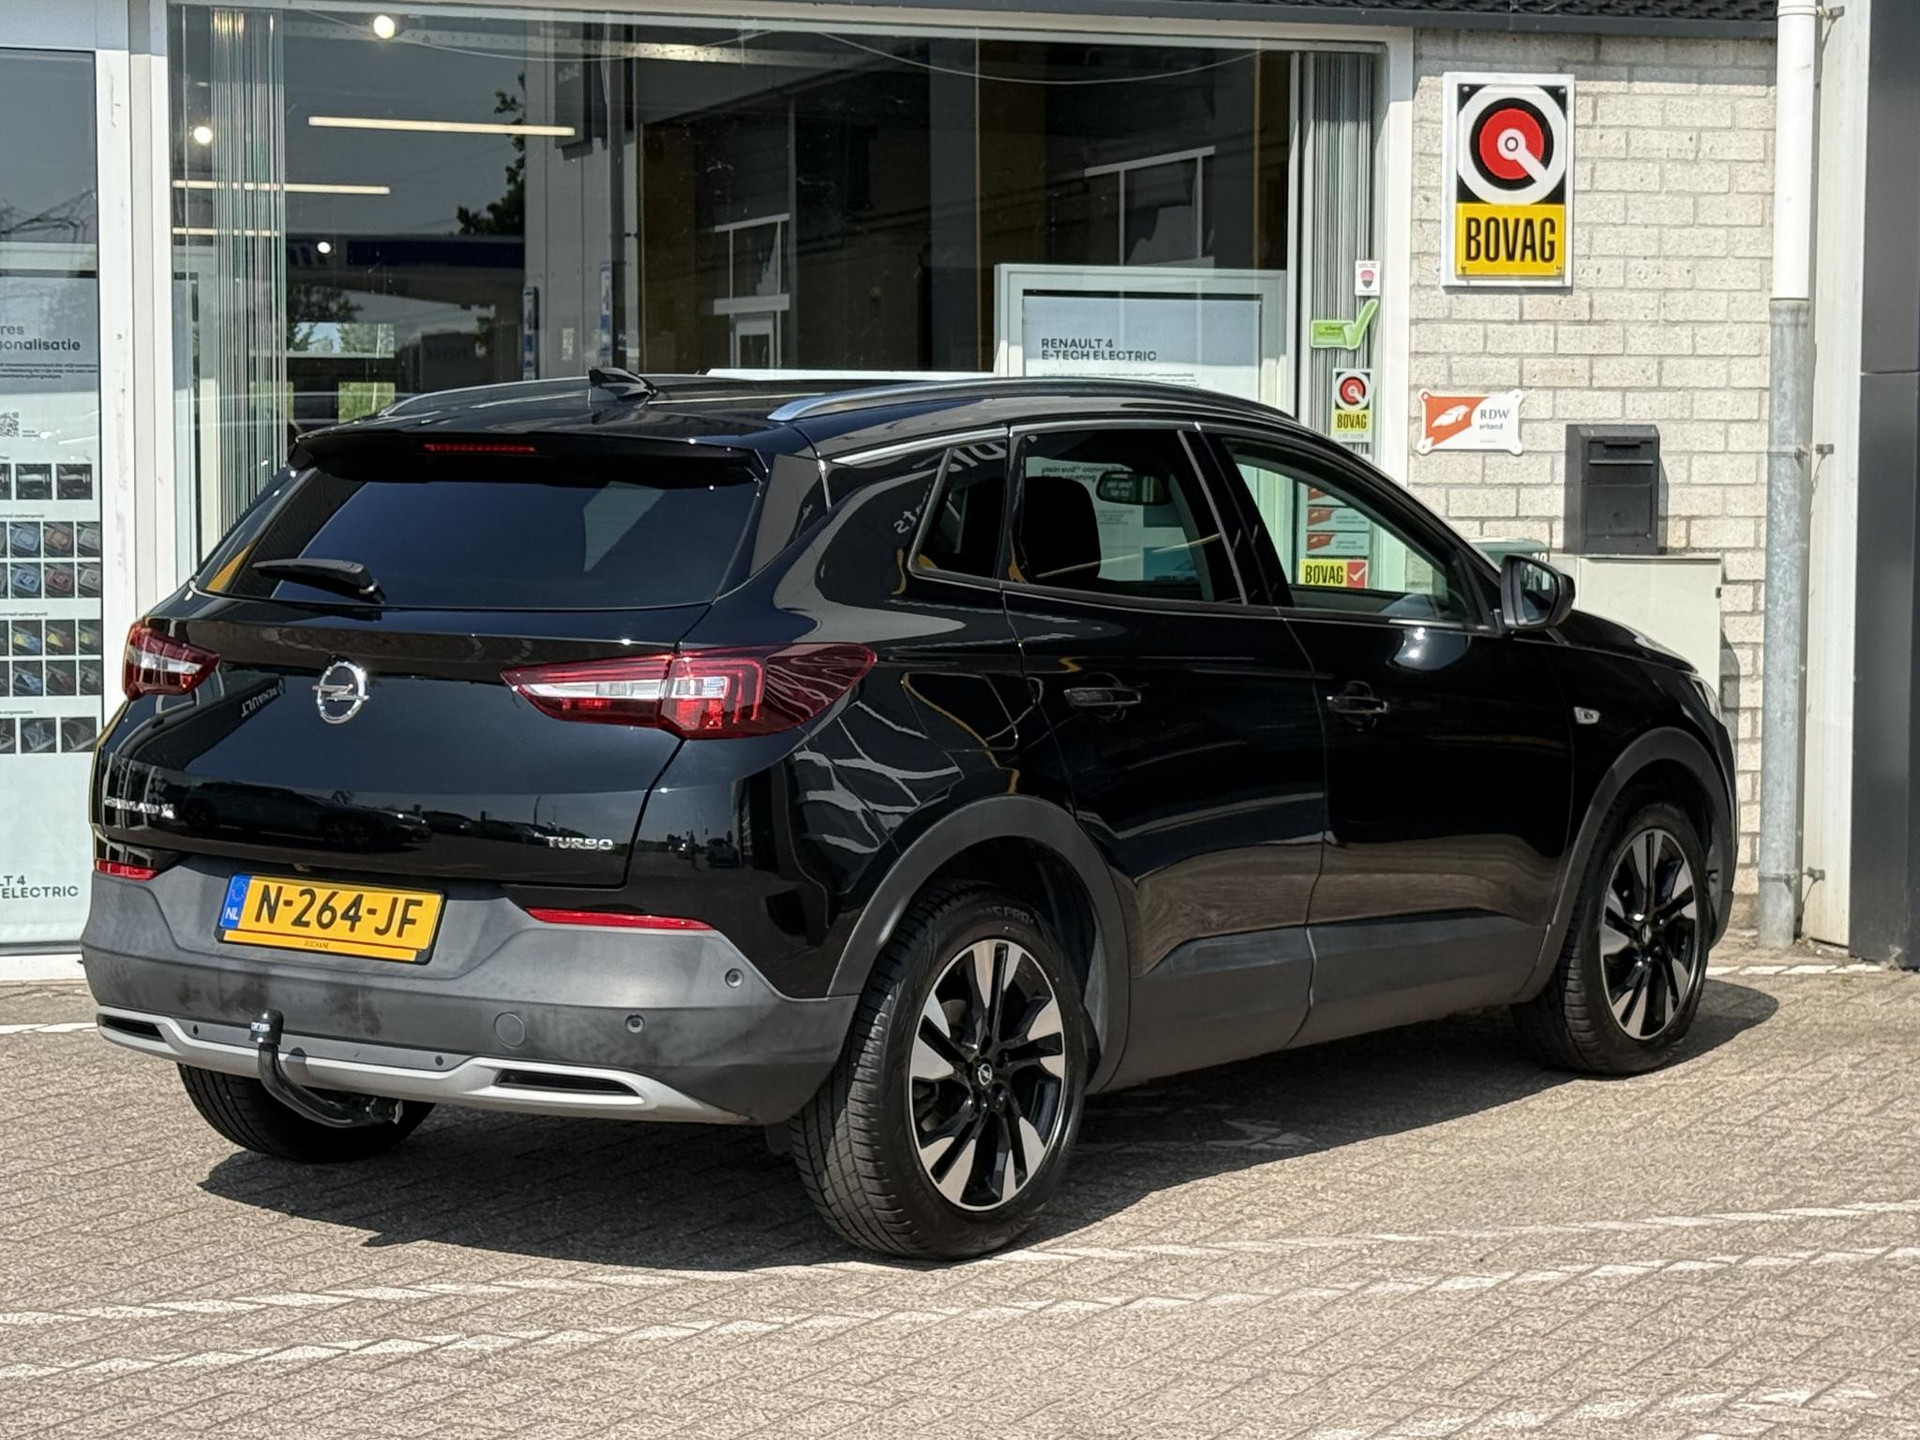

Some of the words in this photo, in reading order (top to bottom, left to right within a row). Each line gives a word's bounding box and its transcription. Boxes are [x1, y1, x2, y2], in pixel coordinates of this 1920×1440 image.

[1465, 217, 1556, 263] BOVAG
[1041, 338, 1103, 349] RENAULT
[1105, 338, 1114, 349] 4
[1041, 350, 1090, 360] E-TECH
[1093, 350, 1157, 361] ELECTRIC
[1480, 408, 1510, 420] RDW
[1337, 413, 1367, 429] BOVAG
[1305, 565, 1344, 584] BOVAG
[545, 836, 615, 851] TURBO
[16, 875, 26, 886] 4
[1, 886, 79, 899] ELECTRIC
[224, 907, 239, 920] NL
[254, 884, 424, 939] N-264-JF
